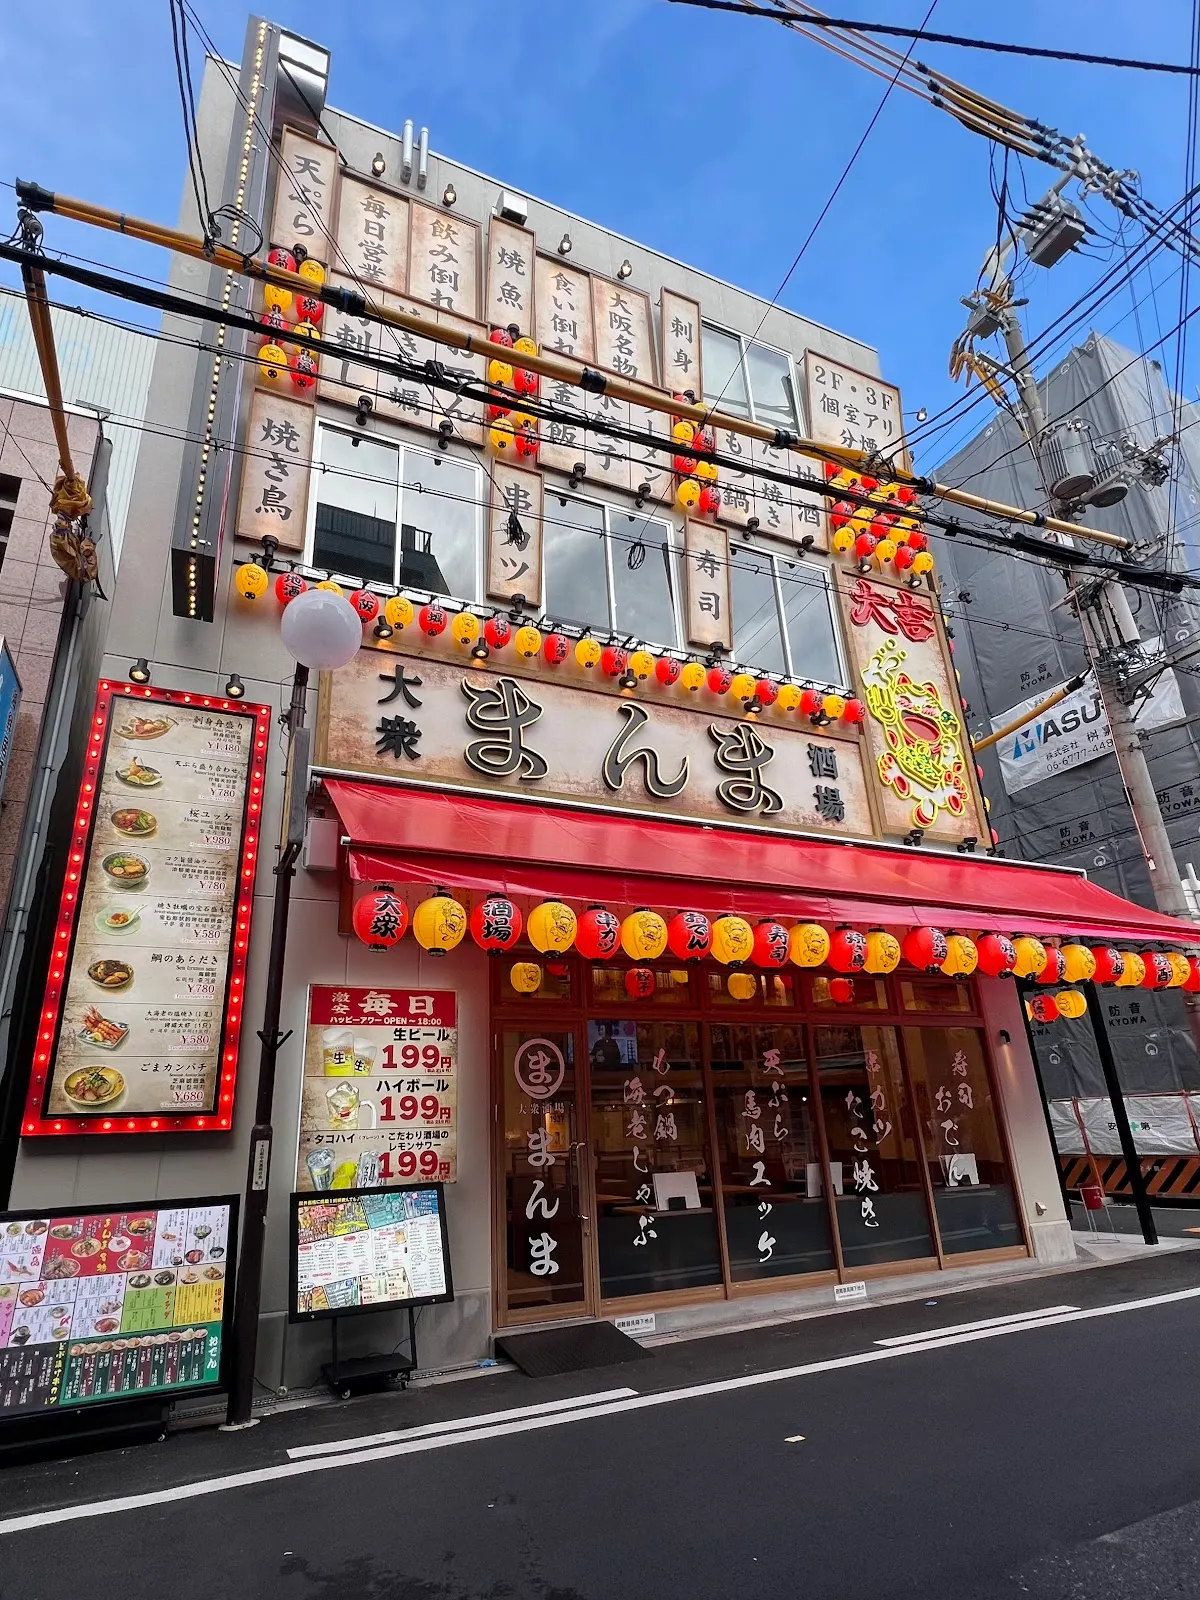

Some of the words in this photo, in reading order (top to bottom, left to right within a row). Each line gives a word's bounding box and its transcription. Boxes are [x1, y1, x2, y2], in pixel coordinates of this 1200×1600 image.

[288, 154, 326, 237] 天ぷら
[358, 194, 391, 285] 毎日営業
[427, 217, 461, 313] 飲み倒れ
[496, 245, 527, 311] 焼魚
[608, 292, 639, 378] 大阪名物
[669, 315, 694, 374] 刺身
[820, 392, 893, 438] 個室アリ
[642, 405, 662, 483] ーメン
[840, 428, 879, 456] 分煙
[255, 417, 301, 521] 焼き鳥
[721, 431, 751, 514] も鍋
[283, 573, 302, 598] 地酒
[695, 549, 722, 621] 寿司
[850, 578, 936, 643] 大吉
[1020, 671, 1053, 692] KYOWA
[375, 663, 424, 761] 大衆
[460, 676, 785, 817] まんま
[807, 742, 845, 822] 酒場
[1046, 737, 1114, 773] 06-6777-448
[189, 808, 234, 821] 桜ユッケ
[204, 836, 231, 845] ¥980
[1060, 831, 1096, 848] KYOWA
[199, 880, 226, 890] ¥780
[194, 929, 221, 939] ¥580
[370, 894, 403, 939] 大衆
[482, 899, 514, 942] 酒場
[595, 911, 620, 953] 串カツ
[684, 911, 709, 951] おでん
[151, 953, 218, 966] 鯛のあらだき
[768, 926, 790, 963] 寿司
[187, 984, 215, 994] ¥780
[331, 991, 351, 1015] 激安
[357, 990, 435, 1017] 毎日
[330, 1016, 382, 1024] ハッピーアワー
[383, 1017, 407, 1025] OPEN
[1108, 1002, 1142, 1018] 防音
[1109, 1015, 1147, 1028] KYOWA
[182, 1035, 210, 1045] ¥580
[393, 1027, 450, 1042] 生ビール
[382, 1044, 451, 1069] 199円
[526, 1050, 553, 1084] ま
[175, 1091, 204, 1101] ¥680
[376, 1079, 450, 1093] ハイボール
[652, 1047, 678, 1142] もつ鍋
[762, 1048, 788, 1142] 天ぷら
[865, 1050, 892, 1145] 串カツ
[951, 1050, 974, 1109] 寿司
[380, 1095, 451, 1121] 199円
[519, 1101, 565, 1115] 大衆酒場
[314, 1133, 355, 1144] タコハイ
[388, 1130, 449, 1141] こだわり酒場の
[389, 1142, 442, 1151] レモンサワー
[935, 1085, 966, 1187] おでん
[378, 1150, 451, 1178] 199円
[623, 1076, 658, 1247] 海老しゃぶ
[741, 1090, 777, 1263] 馬肉ユッケ
[845, 1090, 880, 1228] たこ焼き
[525, 1127, 560, 1276] まんま
[207, 1336, 218, 1369] おでん
